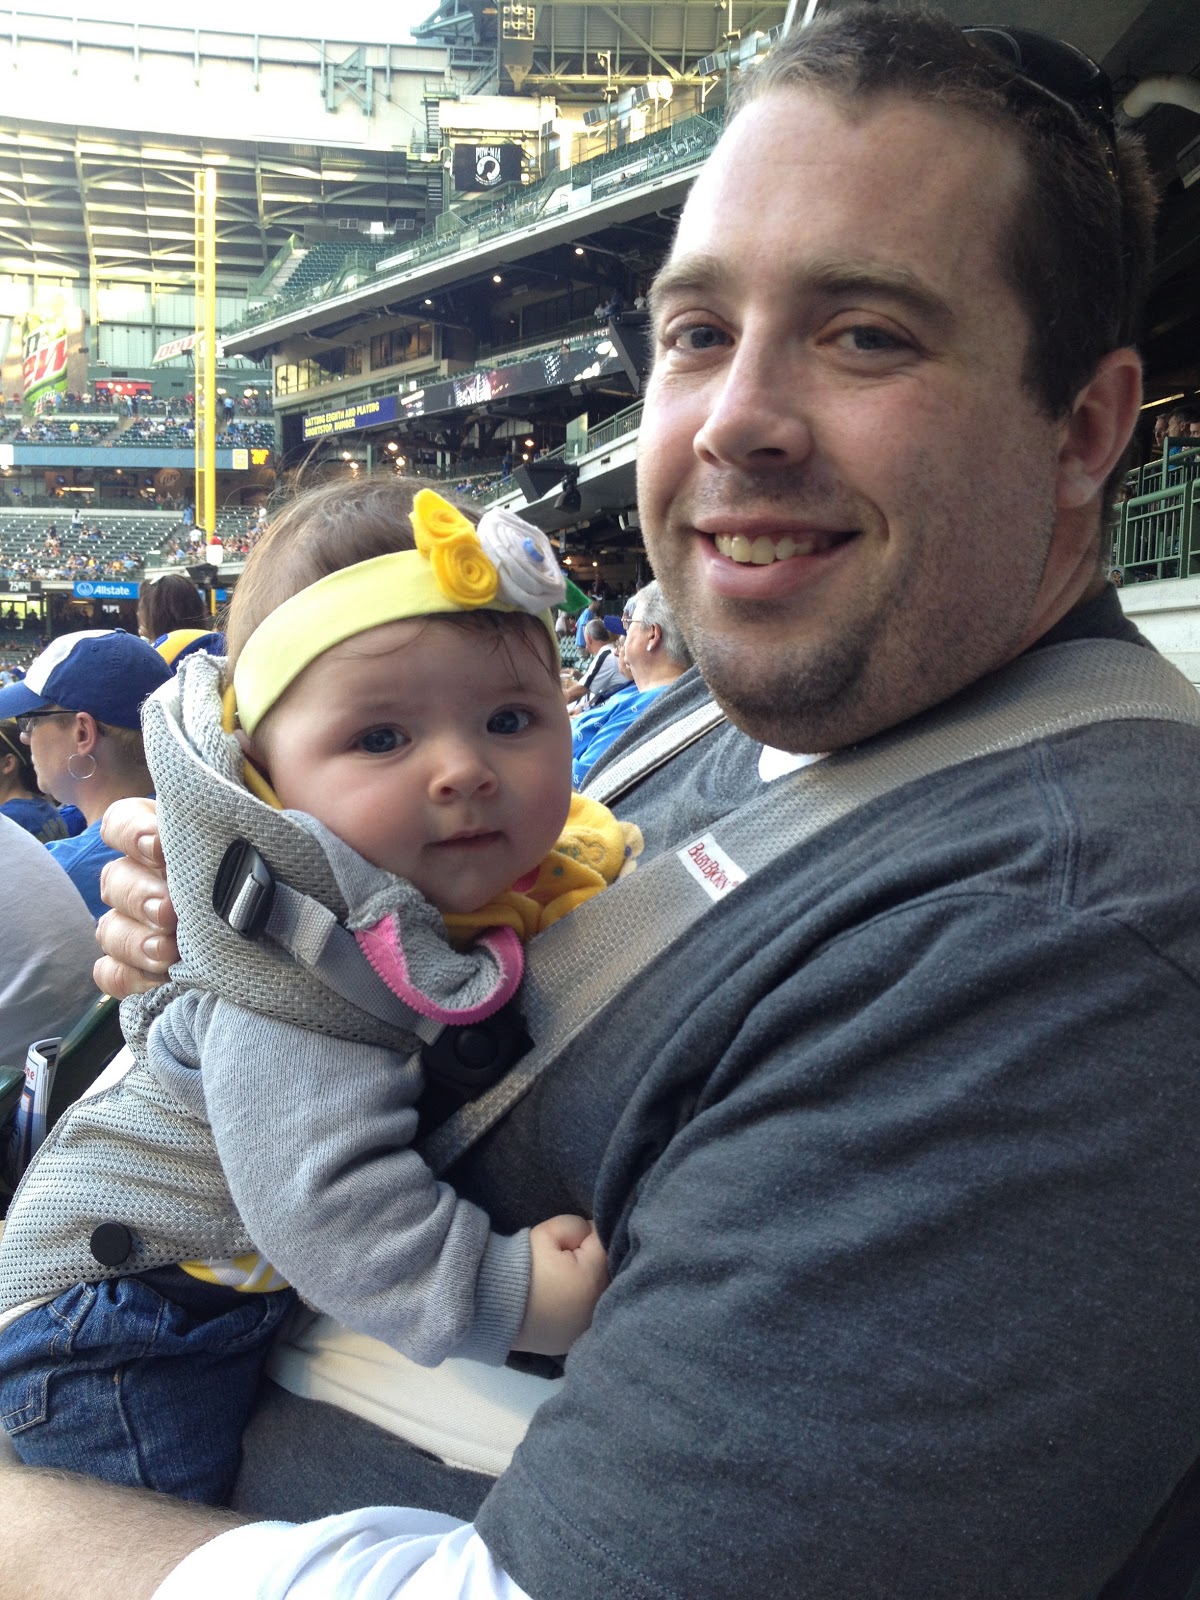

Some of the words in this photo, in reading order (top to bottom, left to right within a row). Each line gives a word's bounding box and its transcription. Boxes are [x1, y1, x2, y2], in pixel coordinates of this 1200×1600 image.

[305, 415, 325, 428] BATTING
[325, 410, 345, 423] EIGHTH
[345, 407, 356, 418] AND
[356, 401, 380, 416] PLAYING
[334, 418, 356, 431] NUMBER
[94, 585, 131, 596] Allstate
